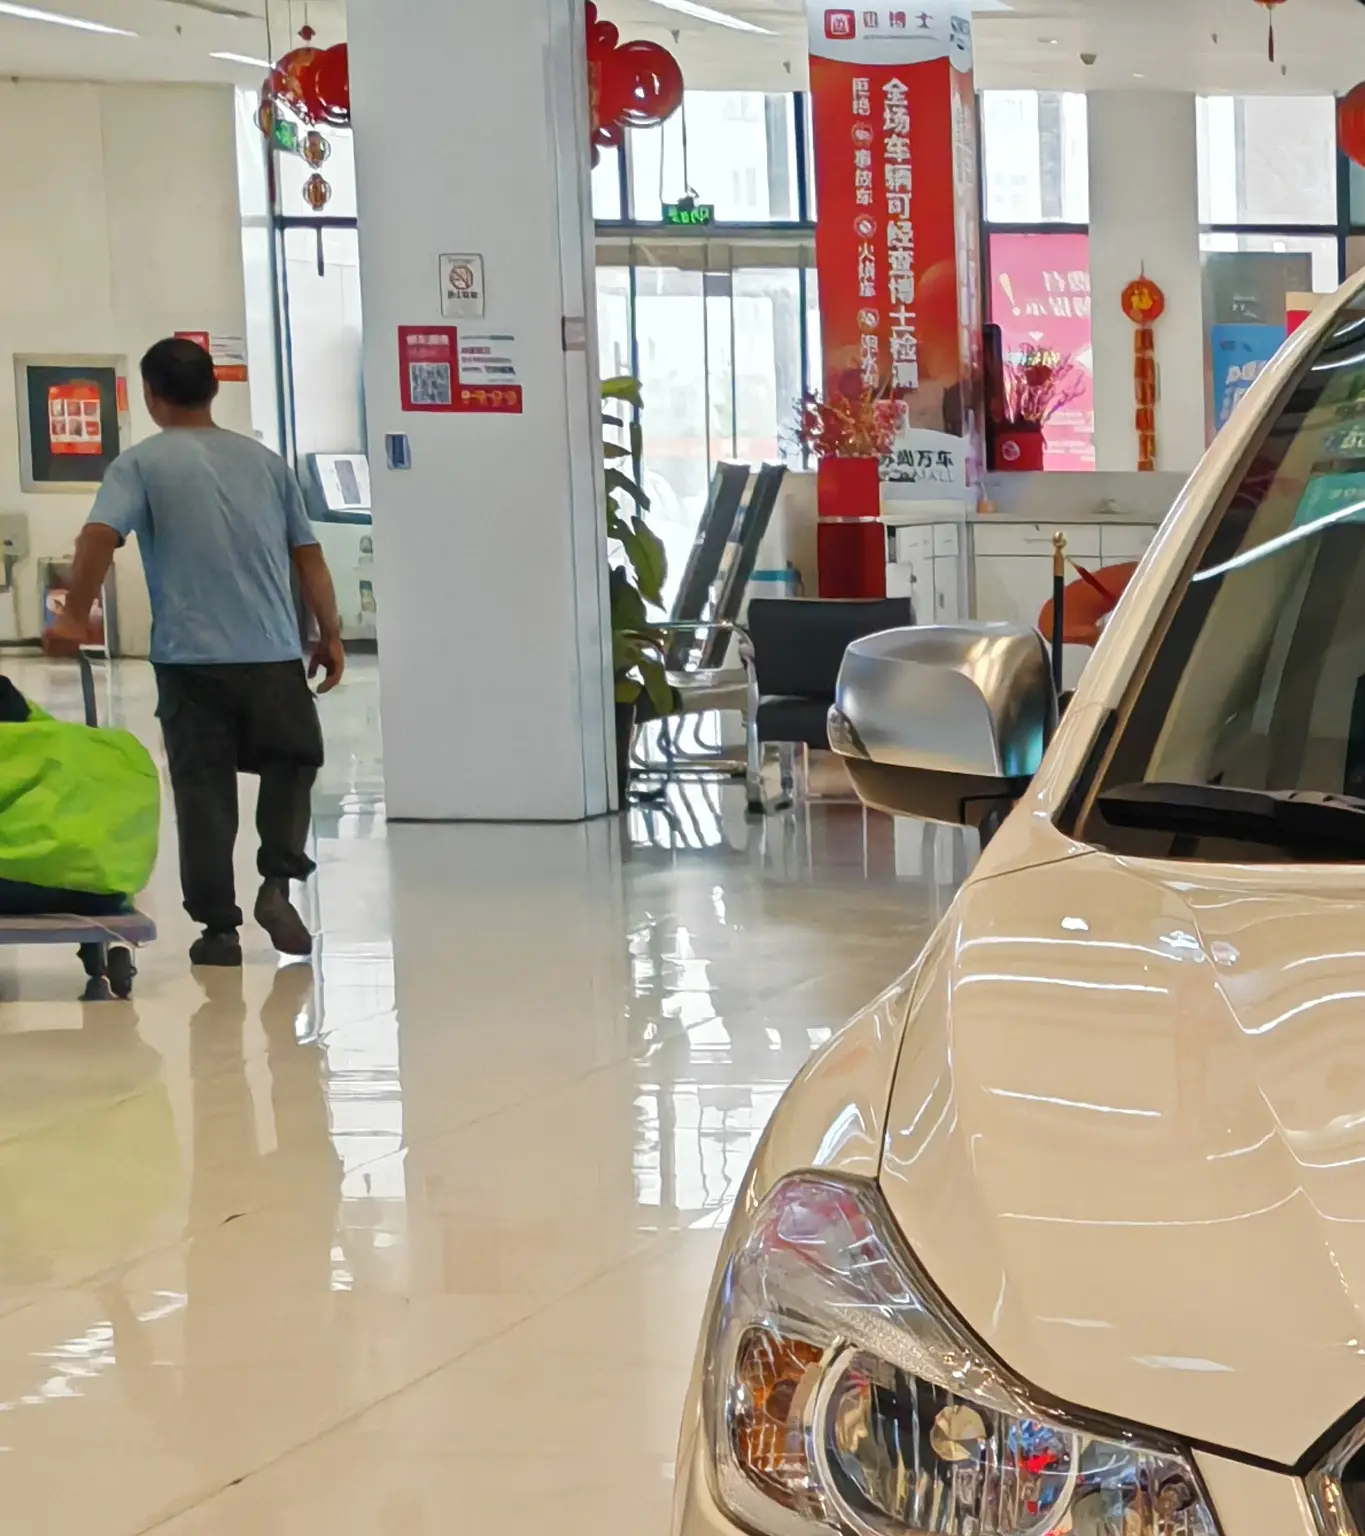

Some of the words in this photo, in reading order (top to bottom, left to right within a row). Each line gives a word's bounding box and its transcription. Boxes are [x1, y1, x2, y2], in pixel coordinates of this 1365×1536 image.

[882, 77, 919, 388] 全场车辆可经查博士检测
